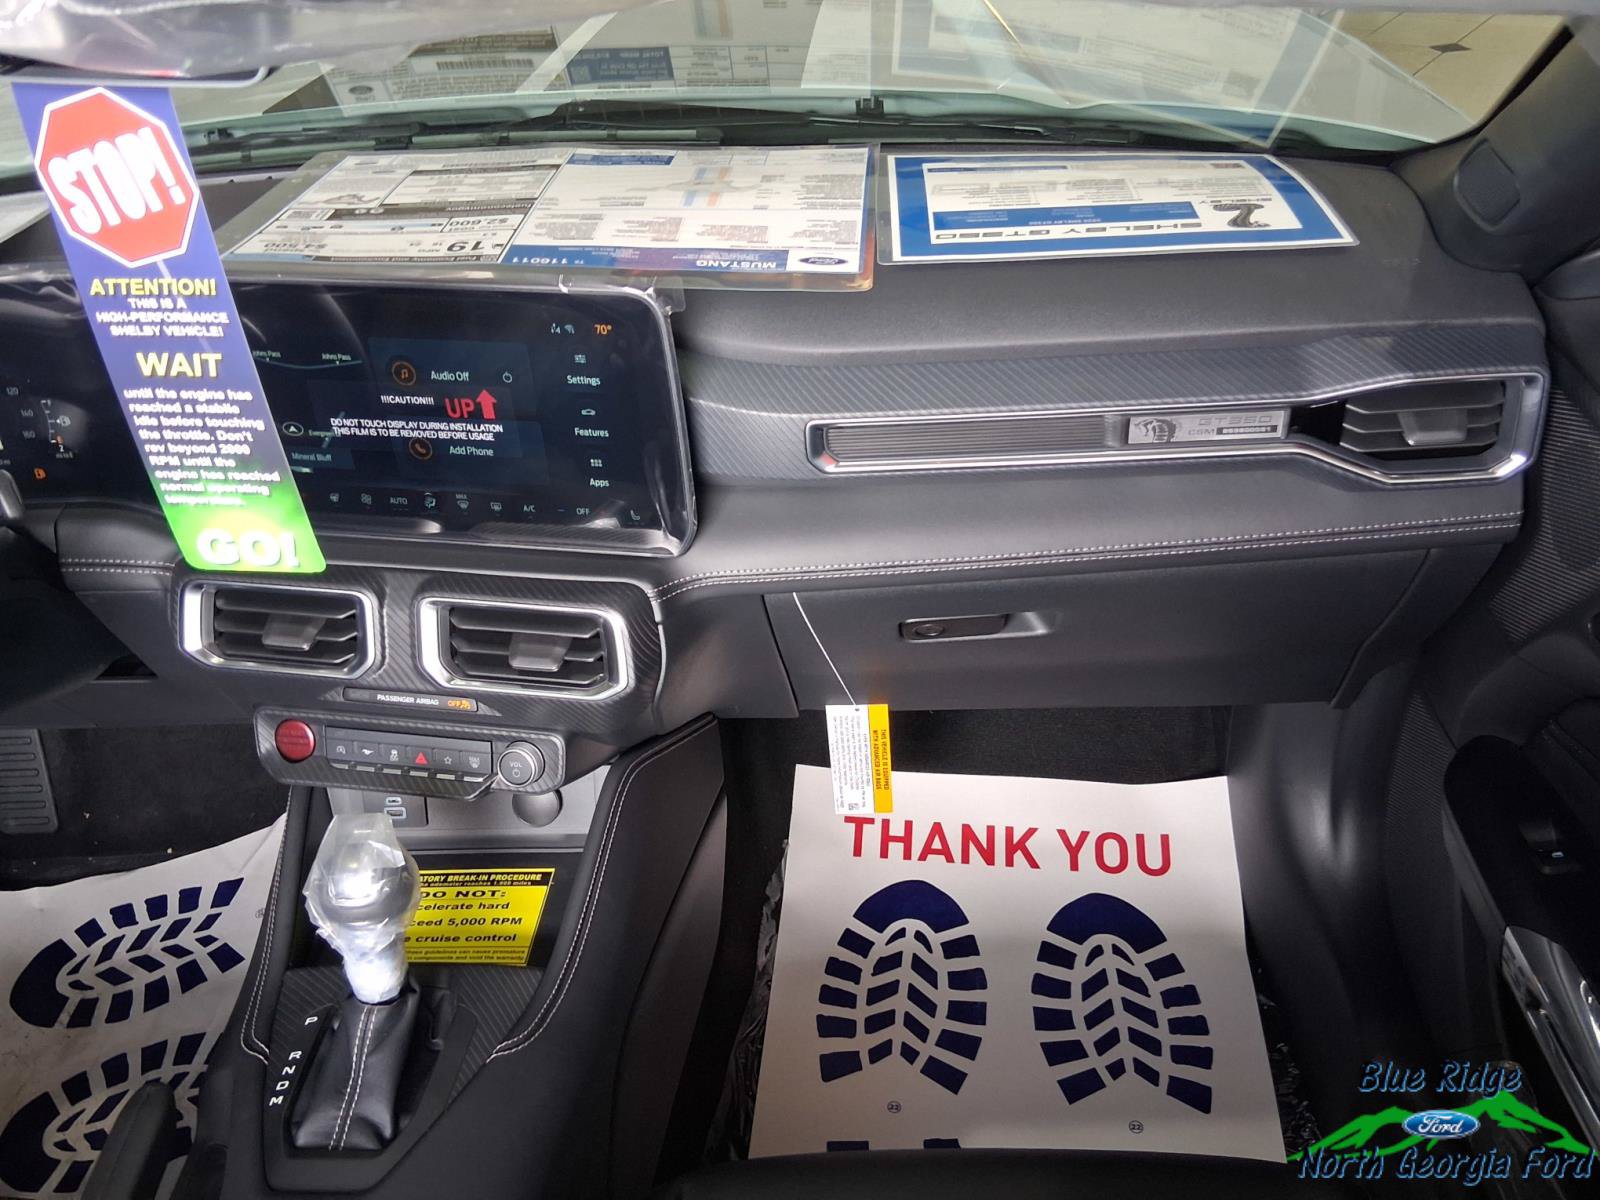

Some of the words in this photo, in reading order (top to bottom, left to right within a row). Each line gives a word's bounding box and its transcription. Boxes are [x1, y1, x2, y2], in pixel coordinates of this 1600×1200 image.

[48, 126, 186, 235] STOP!
[1063, 222, 1202, 235] SHELBY
[446, 240, 485, 252] 19
[695, 259, 777, 269] MUSTANG
[90, 278, 217, 296] ATTENTION!
[127, 298, 159, 309] THIS
[160, 298, 174, 309] IS
[176, 298, 187, 310] A
[96, 311, 229, 324] HIGH-PERFORMANCE
[110, 325, 160, 337] SHELBY
[136, 352, 222, 377] WAIT
[431, 370, 455, 381] Audio
[456, 371, 469, 382] Off
[566, 375, 601, 387] Settings
[123, 388, 154, 399] until
[155, 388, 178, 399] the
[179, 389, 226, 402] engine
[226, 389, 253, 401] has
[381, 395, 434, 406] !!!CAUTION!!!
[128, 402, 182, 412] reached
[184, 404, 194, 413] a
[444, 398, 475, 419] UP
[133, 415, 159, 426] idle
[159, 416, 204, 427] before
[204, 417, 265, 431] touching
[330, 418, 343, 426] DO
[343, 418, 359, 427] NOT
[360, 419, 387, 428] TOUCH
[387, 420, 418, 429] DISPLAY
[419, 421, 449, 430] DURING
[450, 423, 503, 432] INSTALLATION
[1199, 415, 1272, 426] GT350
[138, 429, 161, 440] the
[333, 426, 351, 435] THIS
[351, 427, 369, 436] FILM
[369, 428, 377, 436] IS
[378, 428, 389, 437] TO
[389, 428, 400, 437] BE
[400, 429, 438, 439] REMOVED
[438, 431, 468, 440] BEFORE
[468, 432, 495, 441] USAGE
[574, 428, 609, 438] Features
[144, 443, 166, 453] rev
[166, 443, 217, 456] beyond
[450, 446, 466, 455] Add
[467, 446, 494, 456] Phone
[148, 455, 181, 466] RPM
[182, 456, 213, 467] until
[213, 457, 236, 468] the
[154, 469, 199, 481] engine
[200, 470, 225, 480] has
[227, 471, 281, 482] reached
[589, 478, 610, 488] Apps
[389, 497, 408, 505] AUTO
[523, 504, 536, 513] A/C
[576, 507, 590, 516] OFF
[196, 528, 300, 567] GO!
[376, 694, 415, 704] PASSENGER
[416, 696, 439, 706] AIRBAG
[844, 816, 1041, 870] THANK
[1056, 828, 1172, 877] YOU
[448, 874, 488, 882] BREAK-IN
[490, 873, 542, 881] PROCEDURE
[455, 890, 506, 898] NOT:
[416, 902, 473, 911] celerate
[477, 902, 510, 910] hard
[447, 917, 487, 927] 5,000
[491, 917, 522, 926] RPM
[415, 934, 461, 943] cruise
[465, 933, 516, 942] control
[304, 1016, 318, 1026] P
[288, 1050, 302, 1061] R
[281, 1065, 296, 1076] N
[275, 1080, 290, 1091] D
[269, 1095, 284, 1106] M
[1131, 1123, 1142, 1131] 22
